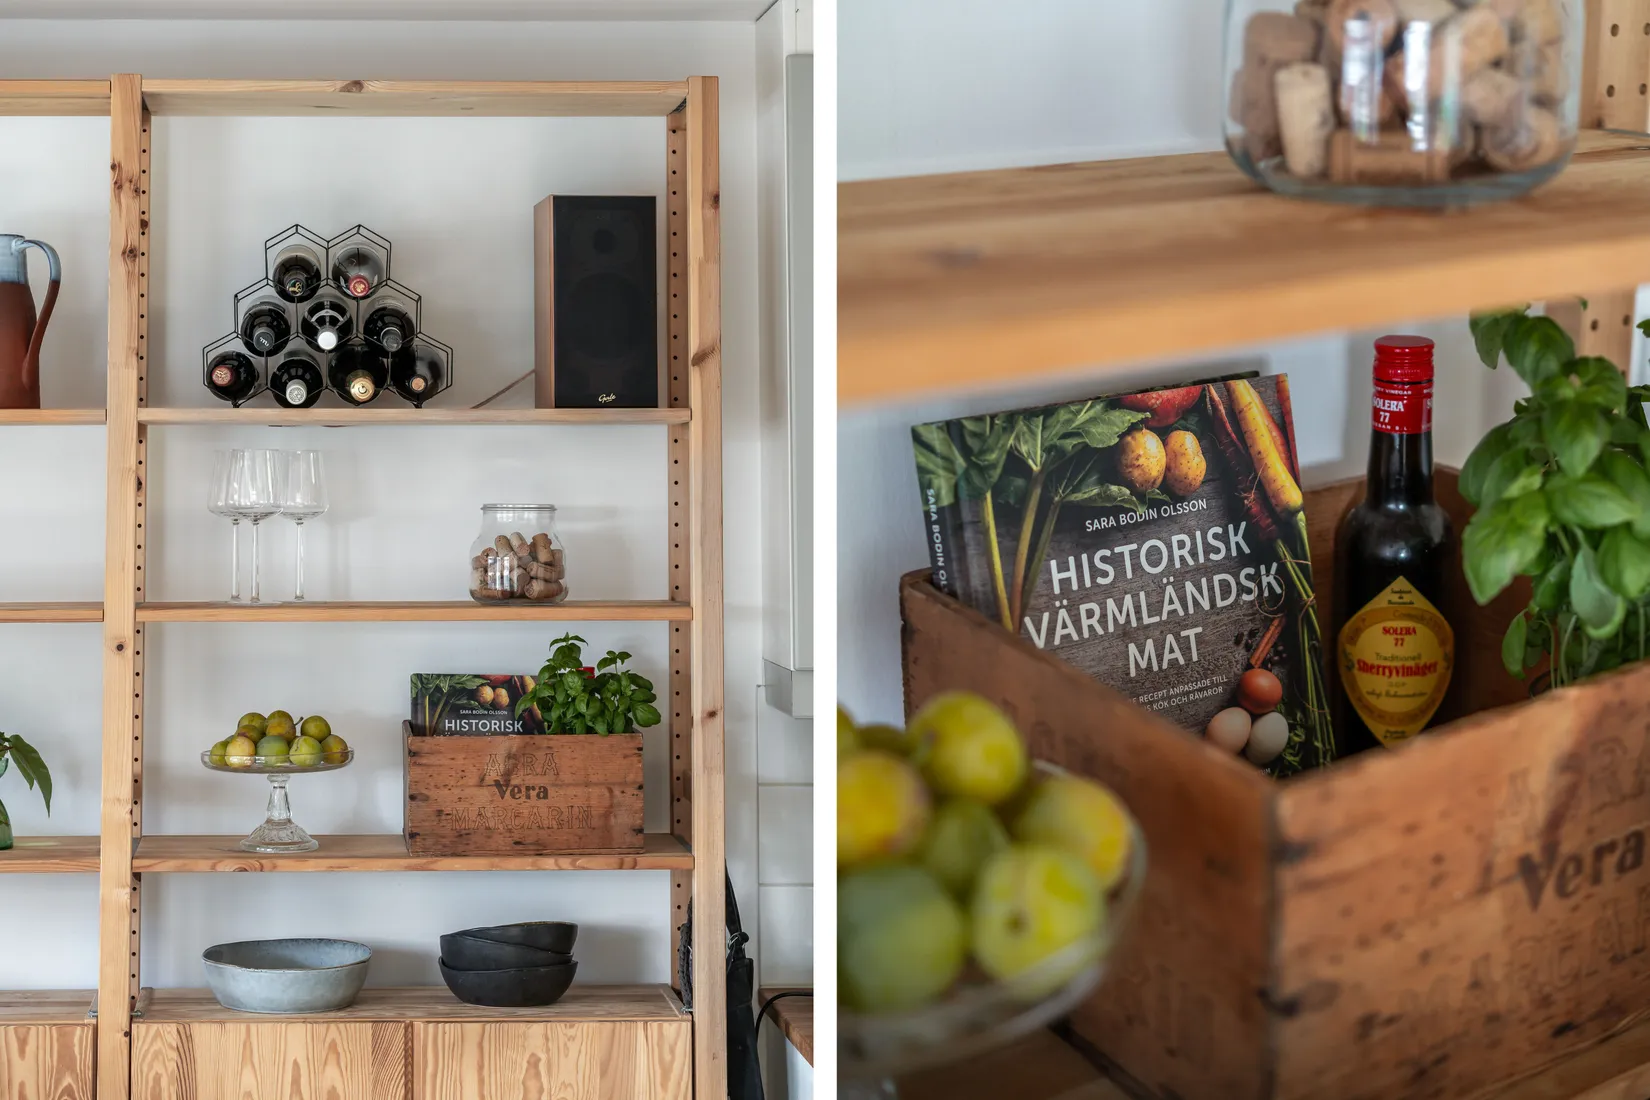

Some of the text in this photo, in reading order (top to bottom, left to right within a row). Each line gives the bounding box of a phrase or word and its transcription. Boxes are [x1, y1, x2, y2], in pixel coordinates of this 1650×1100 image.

[1379, 411, 1390, 423] 77
[926, 488, 938, 521] SARA
[1085, 499, 1207, 532] SARA BODIN OLSSON
[931, 524, 945, 567] BODIN
[1050, 521, 1251, 595] HISTORISK
[1023, 562, 1283, 649] VÄRMLÄNDSK
[1381, 625, 1417, 636] SOLERA
[1393, 637, 1405, 647] 77
[1128, 627, 1203, 677] MAT
[1356, 658, 1439, 679] Sherryvinäger
[1139, 689, 1168, 703] RECEPT
[1169, 678, 1211, 696] ANPASSADE
[1212, 674, 1228, 685] TILL
[1152, 700, 1169, 711] KÖK
[1170, 696, 1188, 706] OCH
[1189, 686, 1224, 701] RÅVAROR
[445, 719, 523, 732] HISTORISK
[493, 779, 549, 800] Vera
[1518, 827, 1645, 913] Vera
